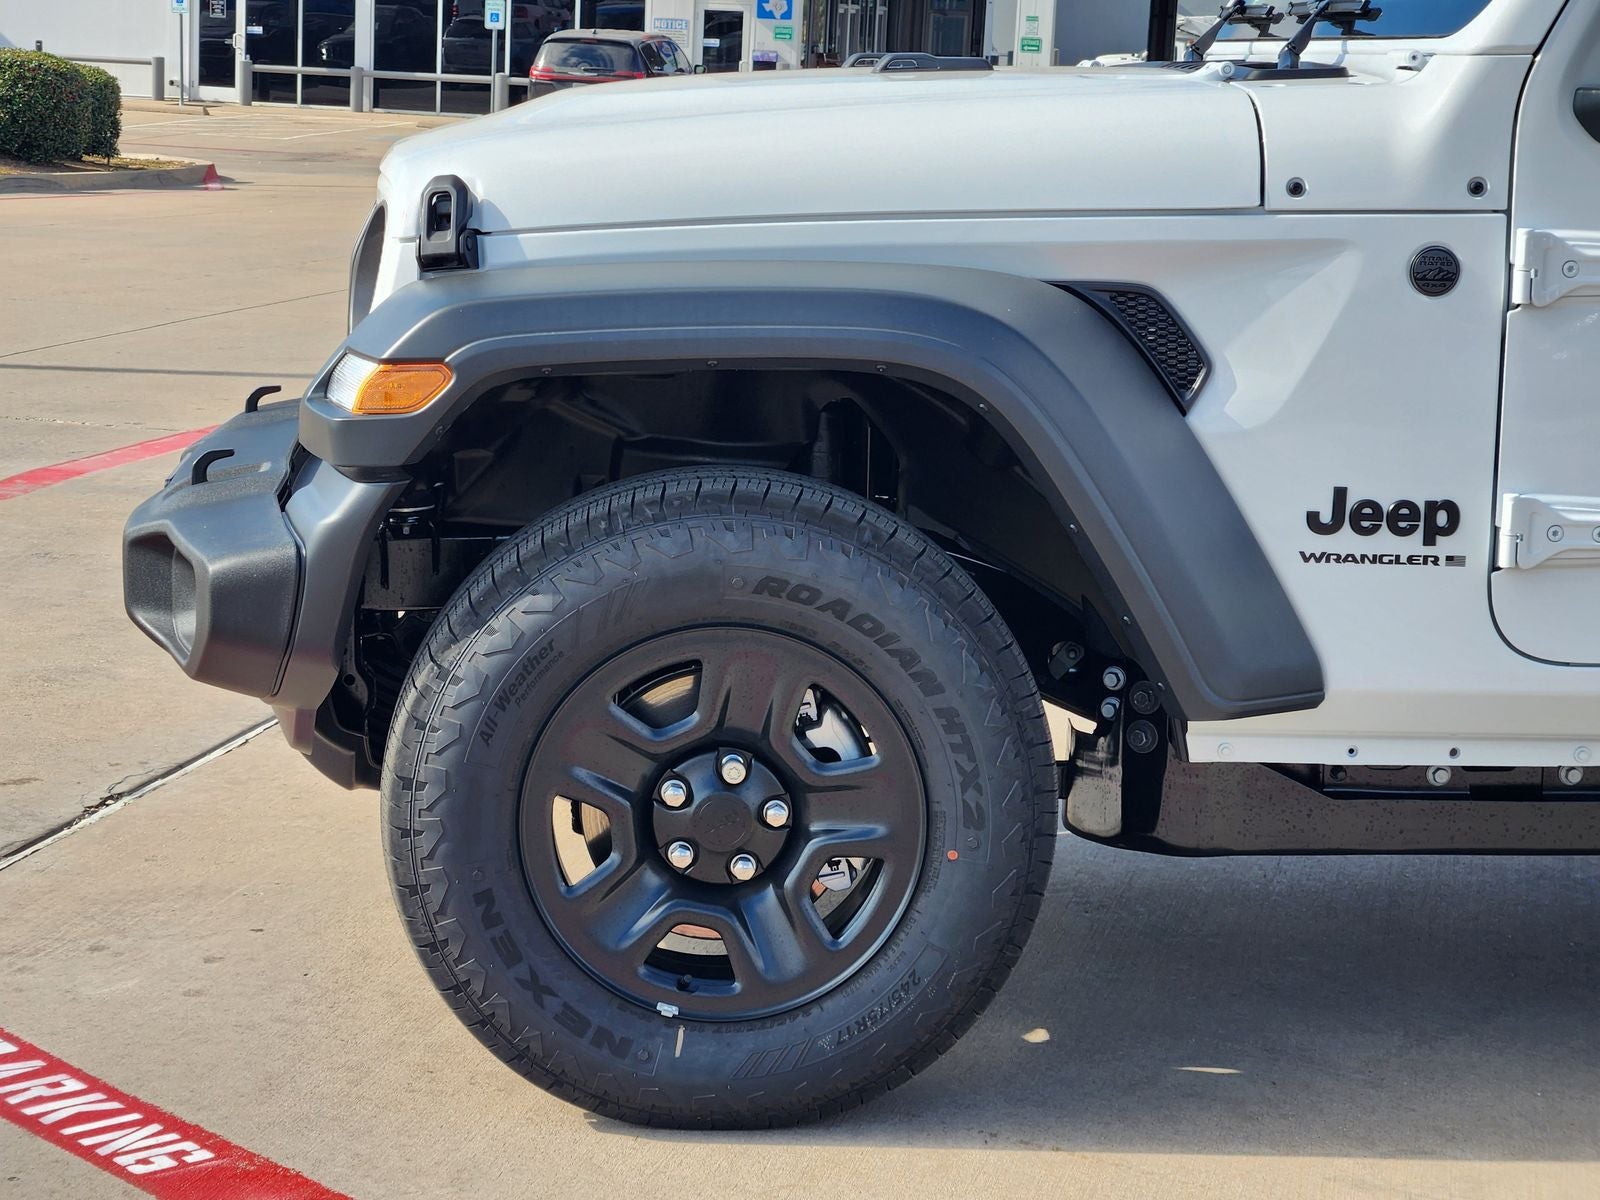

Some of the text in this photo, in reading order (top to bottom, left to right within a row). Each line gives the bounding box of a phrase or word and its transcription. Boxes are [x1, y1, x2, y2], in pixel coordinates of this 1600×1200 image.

[654, 18, 688, 29] NOTICE
[1306, 486, 1461, 546] Jeep
[1299, 551, 1441, 566] WRANGLER
[480, 640, 556, 747] All-Weather
[514, 650, 564, 706] Performance
[752, 575, 986, 832] ROADIAN HTX2
[472, 888, 634, 1060] NEXEN
[0, 1040, 215, 1174] ARKING
